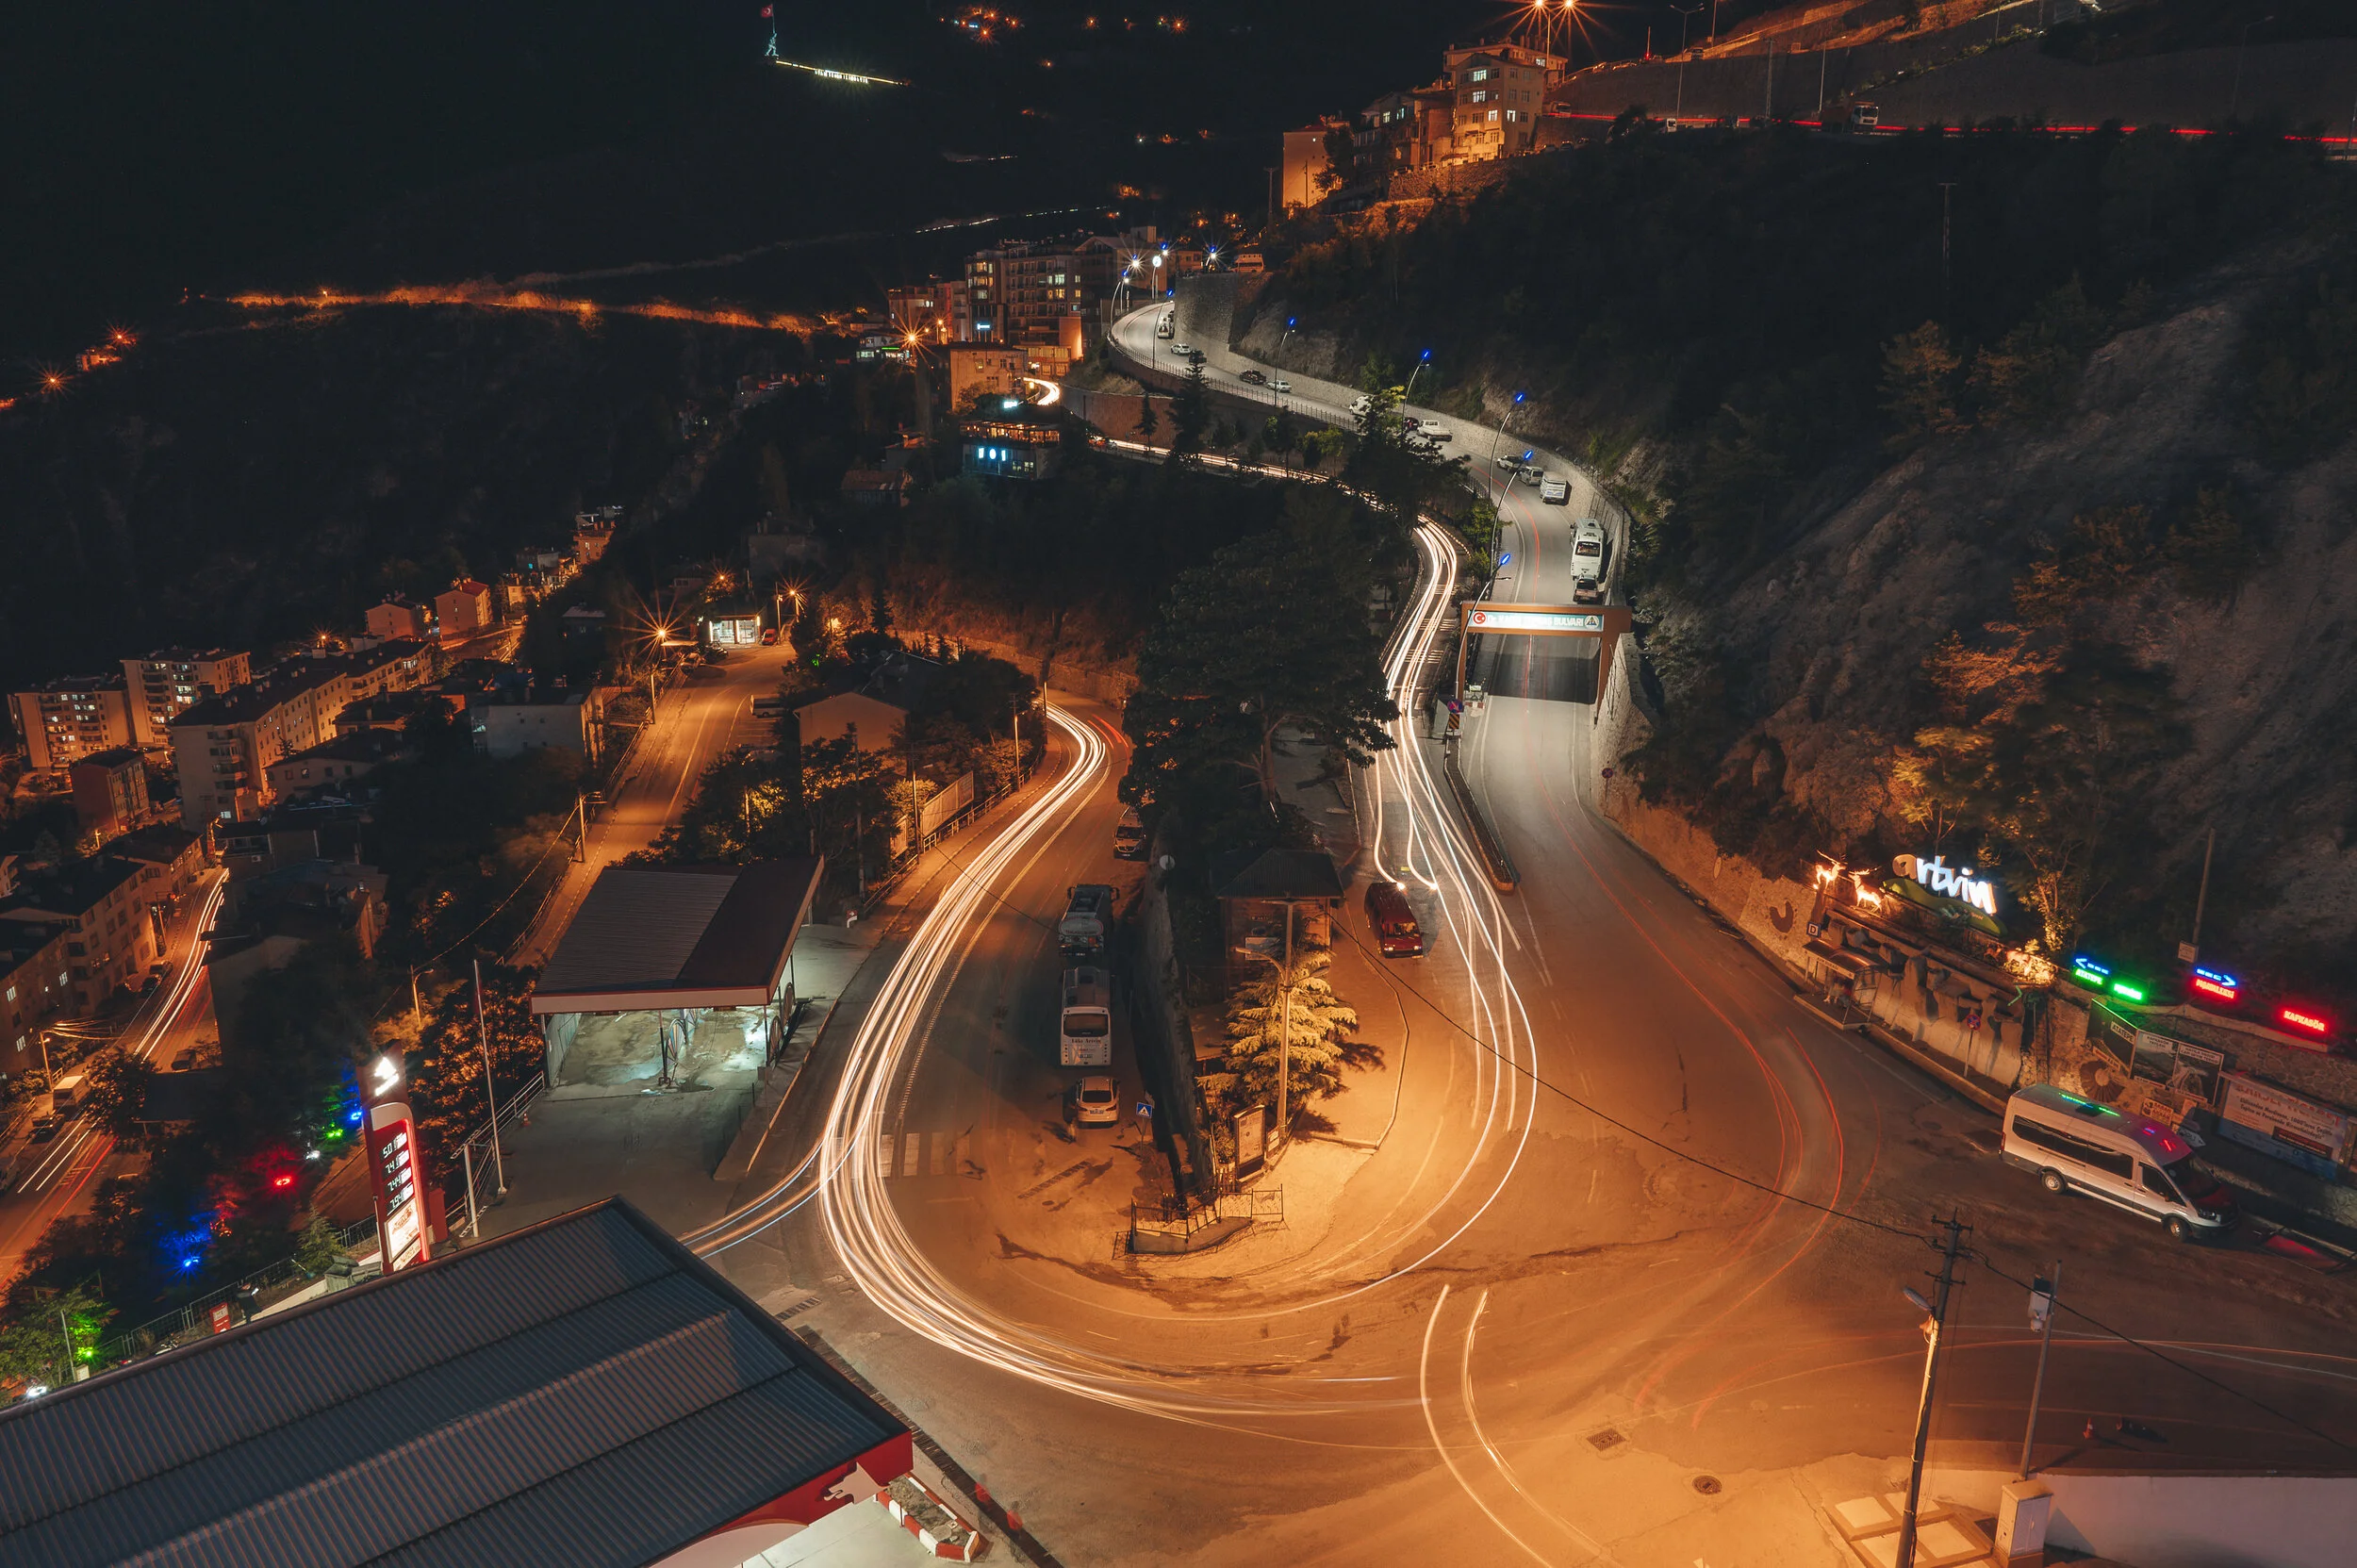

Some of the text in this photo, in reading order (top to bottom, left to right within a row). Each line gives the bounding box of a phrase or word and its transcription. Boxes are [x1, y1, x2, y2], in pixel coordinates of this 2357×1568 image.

[1553, 617, 1584, 627] BULVARI
[1892, 853, 1997, 915] artvin
[2283, 1010, 2325, 1032] KAFKASÖR
[2112, 1024, 2134, 1042] ATATEPE
